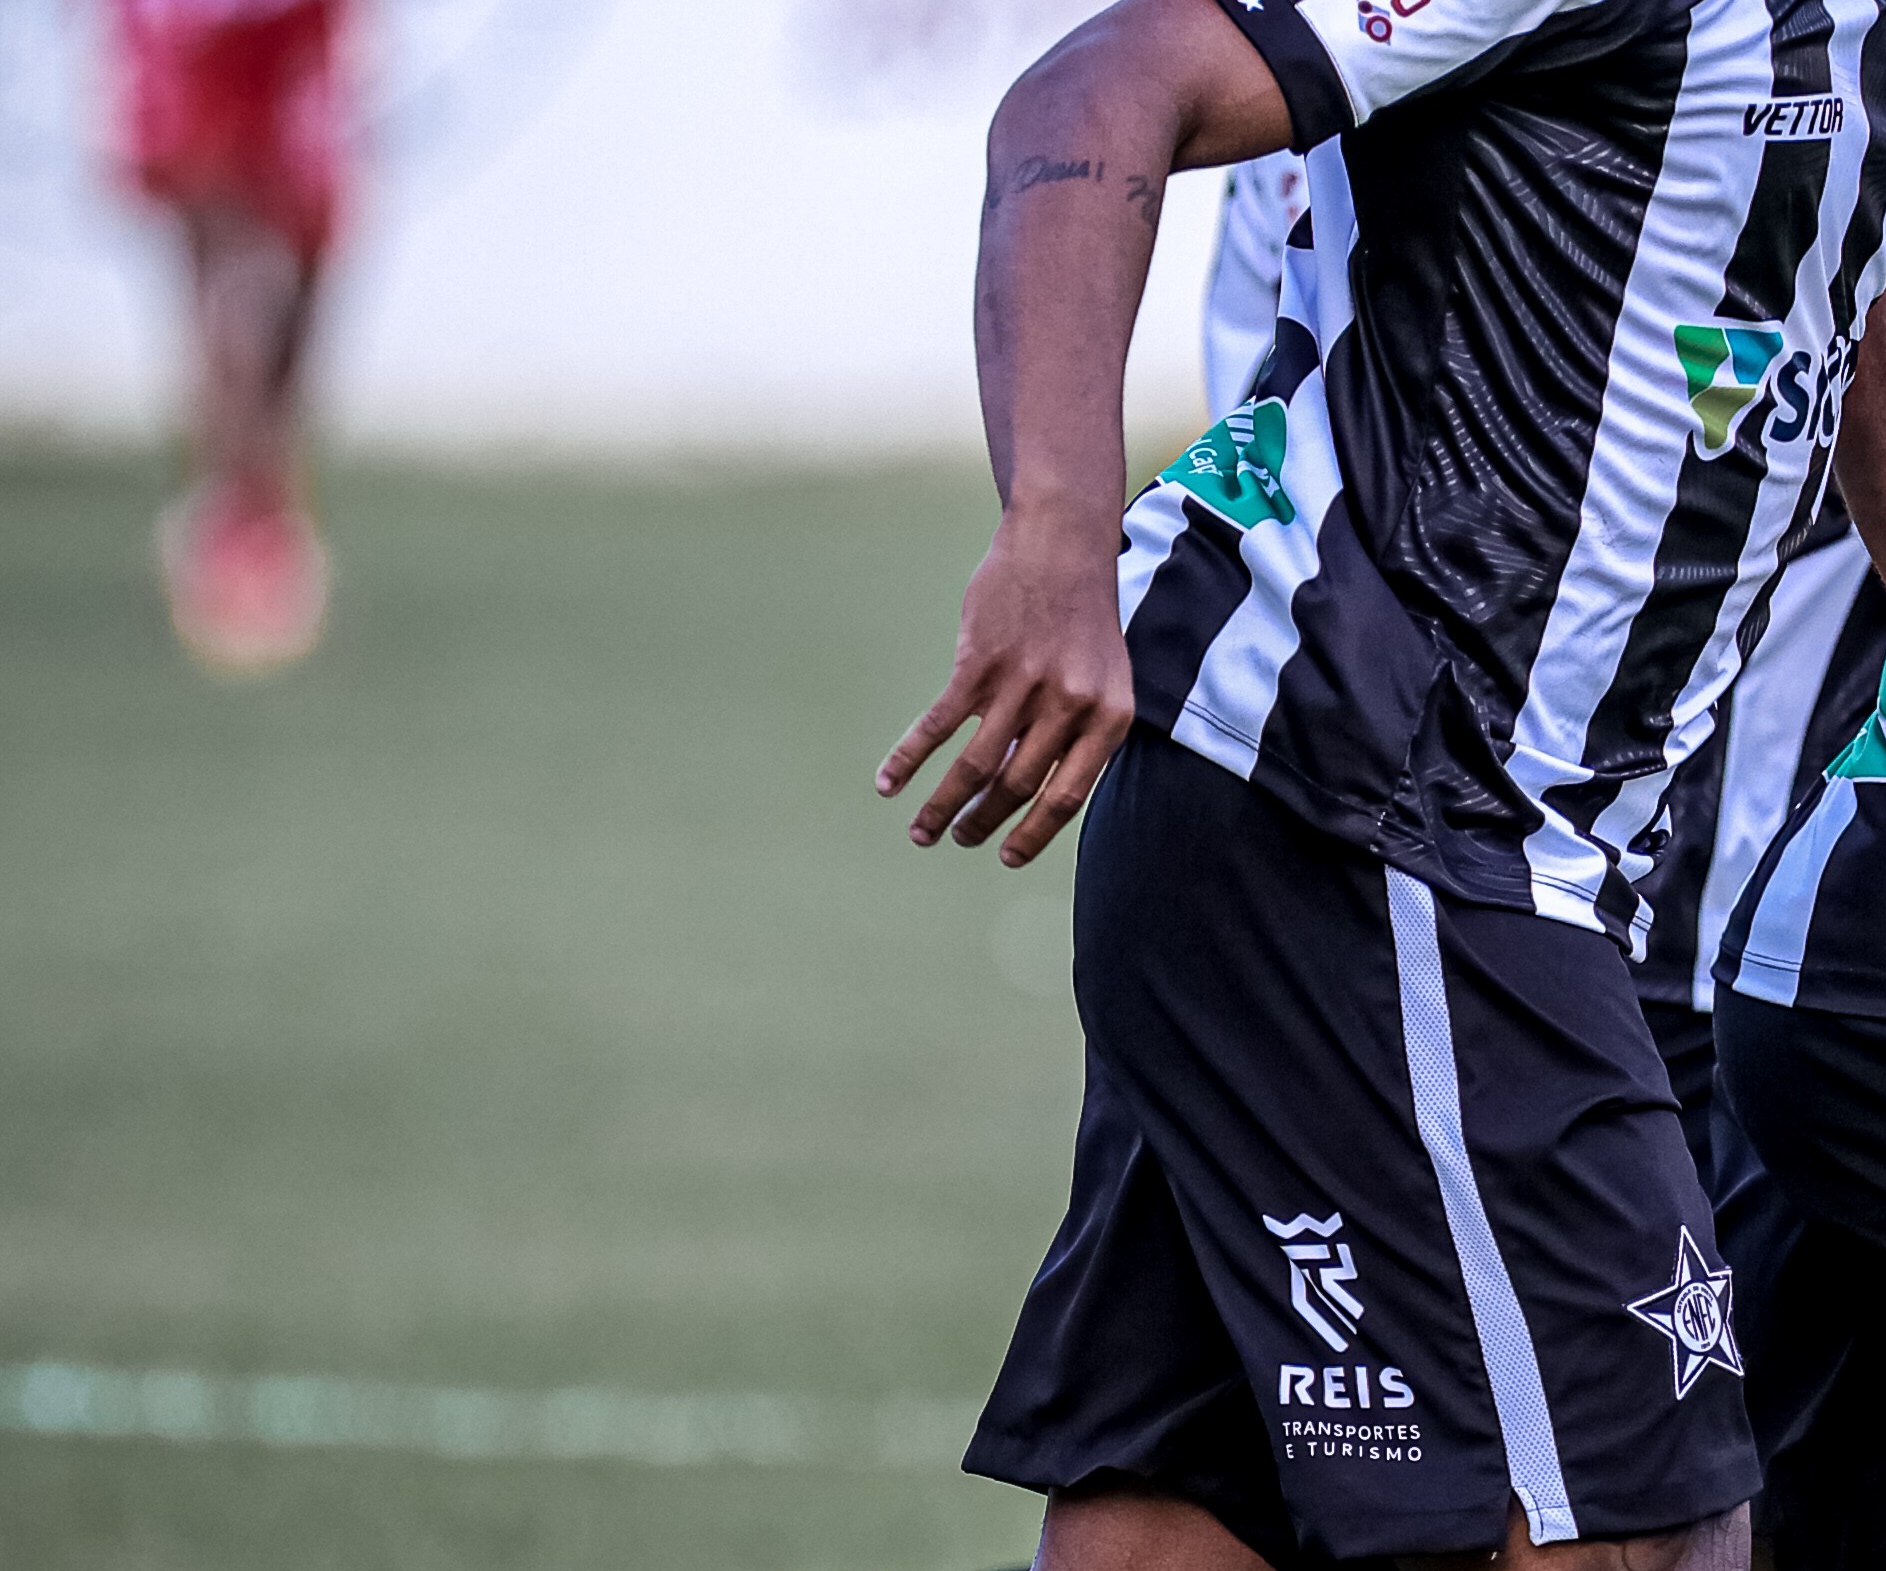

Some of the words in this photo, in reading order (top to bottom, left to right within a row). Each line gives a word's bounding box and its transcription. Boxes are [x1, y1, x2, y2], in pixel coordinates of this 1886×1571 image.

[1743, 97, 1843, 137] VETTOR
[1278, 1364, 1415, 1409] REIS
[1282, 1421, 1421, 1441] TRANSPORTES
[1286, 1443, 1295, 1459] E
[1307, 1442, 1422, 1462] TURISMO
